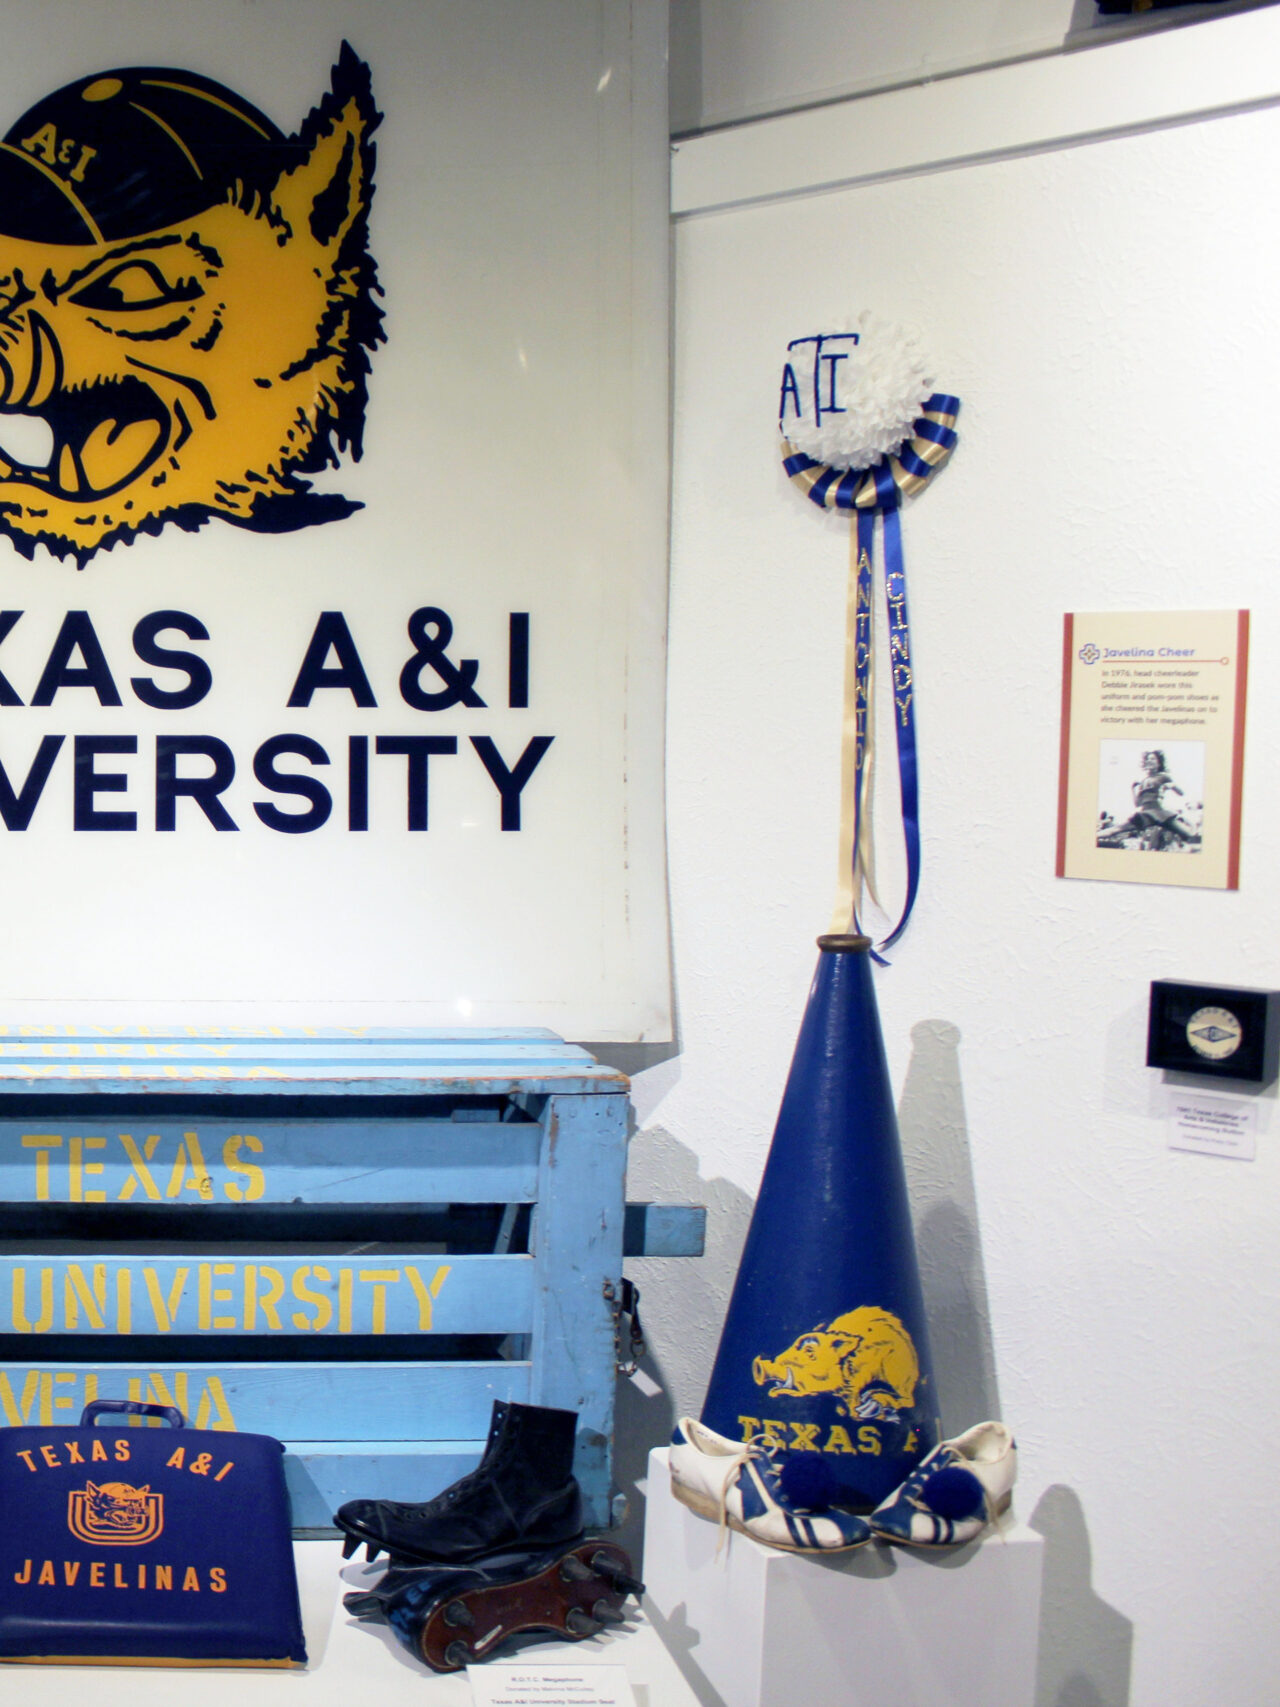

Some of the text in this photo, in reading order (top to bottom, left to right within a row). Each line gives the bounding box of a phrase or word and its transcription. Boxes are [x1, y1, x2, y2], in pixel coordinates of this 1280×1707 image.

[286, 606, 531, 712] A&I
[885, 571, 913, 726] CINDY
[1103, 647, 1195, 658] Javelina Cheer
[21, 1131, 266, 1202] TEXAS
[10, 1261, 453, 1335] UNIVERSITY
[16, 1439, 234, 1482] TEXAS A&I
[738, 1415, 883, 1457] TEXAS
[14, 1559, 228, 1593] JAVELINAS
